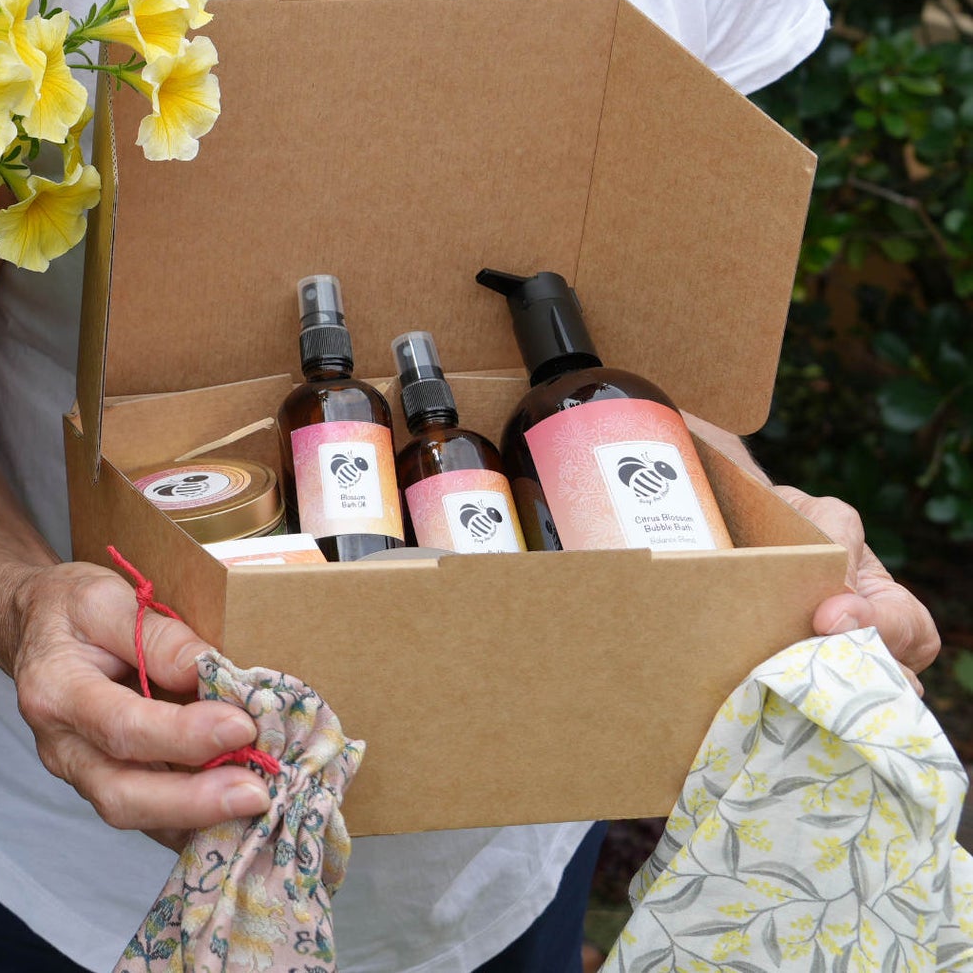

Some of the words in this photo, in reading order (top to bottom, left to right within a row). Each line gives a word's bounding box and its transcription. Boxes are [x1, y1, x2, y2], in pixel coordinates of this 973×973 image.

[635, 514, 660, 524] Citrus
[661, 513, 694, 522] Blossom
[643, 523, 672, 533] Bubble
[673, 522, 693, 532] Bath
